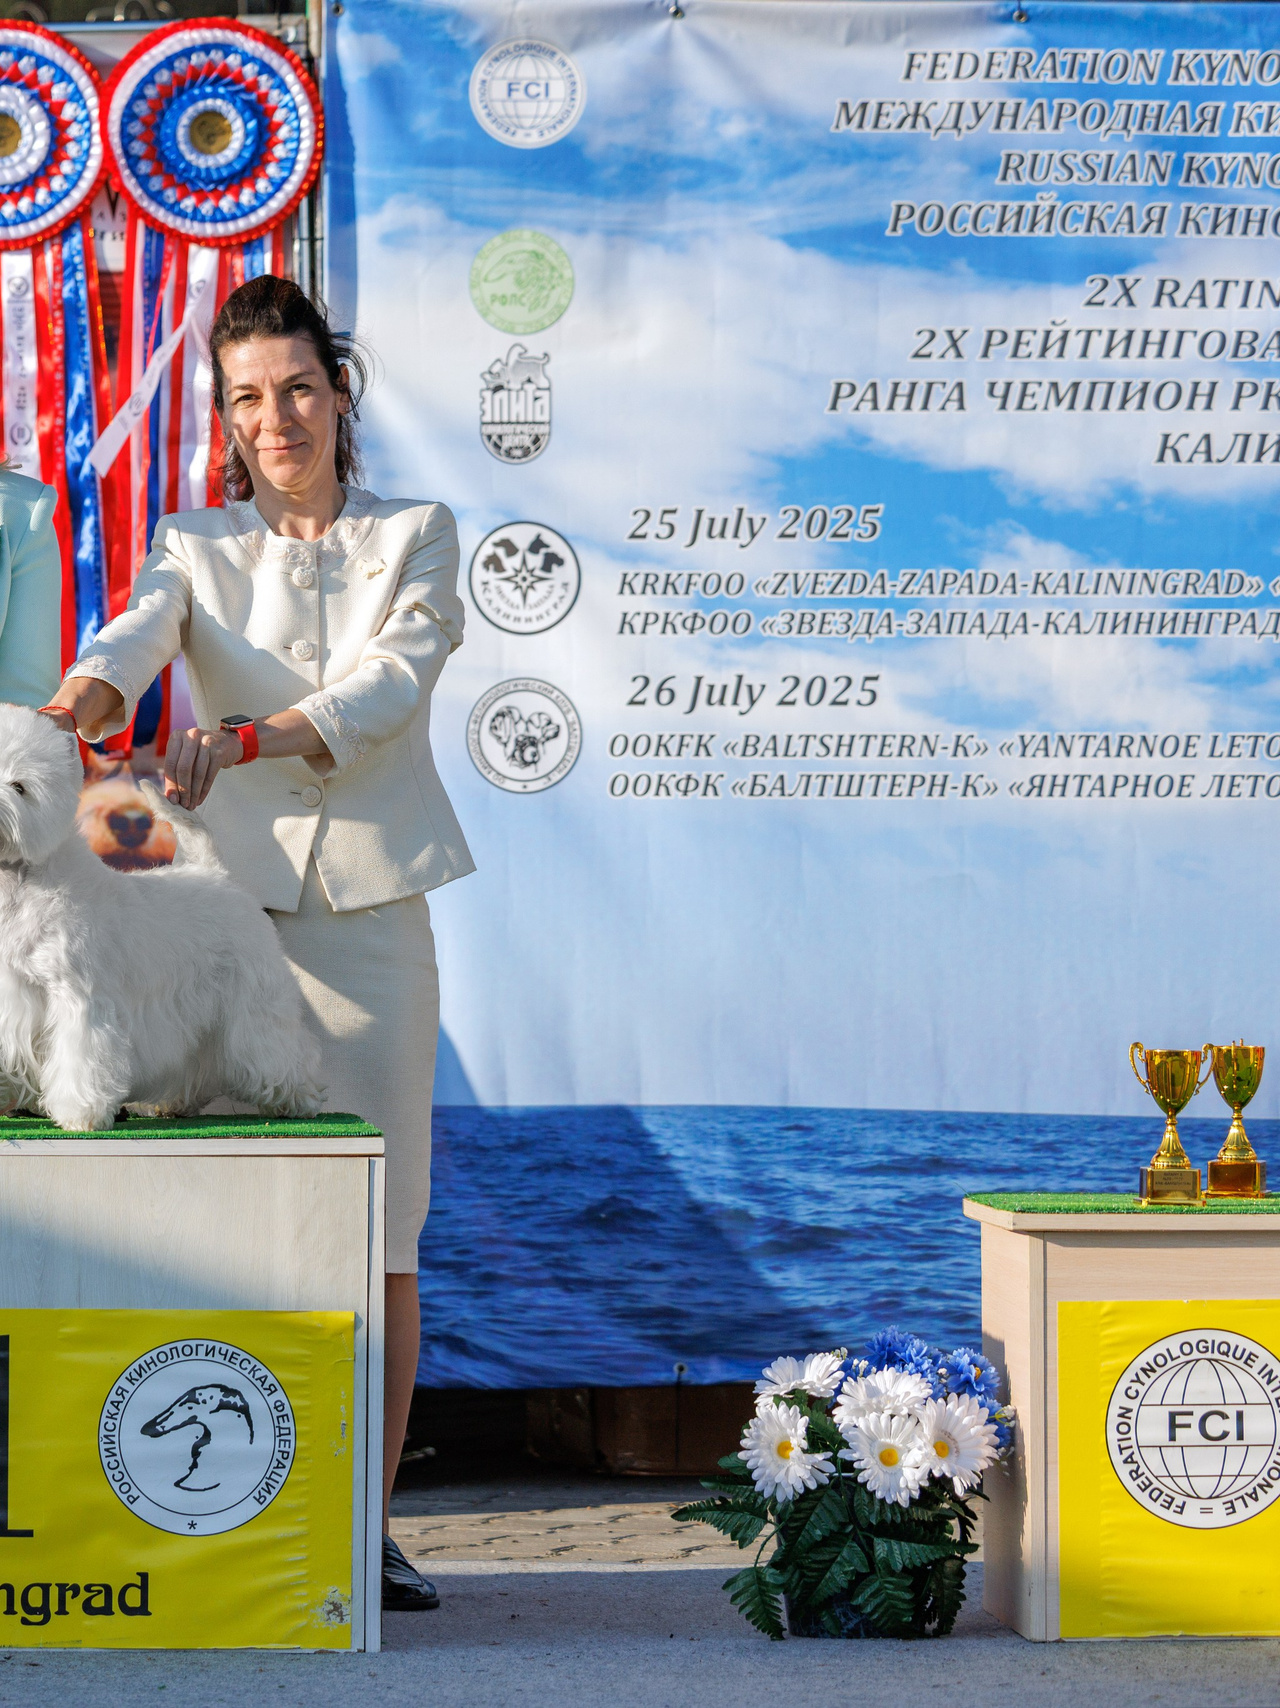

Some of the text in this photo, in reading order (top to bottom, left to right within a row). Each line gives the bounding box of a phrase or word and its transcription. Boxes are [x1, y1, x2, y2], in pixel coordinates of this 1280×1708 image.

[903, 51, 1280, 84] FEDERATION KYNO
[507, 81, 549, 99] FCI
[832, 99, 1223, 140] МЕЖДУНАРОДНАЯ
[998, 151, 1172, 185] RUSSIAN
[888, 193, 1167, 236] РОССИЙСКАЯ
[1084, 276, 1280, 309] 2X RATIN
[910, 320, 1280, 360] 2Х РЕЙТИНГОВА
[826, 380, 1280, 411] РАНГА ЧЕМПИОН РК
[1154, 432, 1280, 464] КАЛИ
[627, 506, 881, 548] 25 July 2025
[617, 570, 1262, 597] KRKFOO «ZVEZDA-ZAPADA-KALININGRAD»
[617, 610, 752, 637] КРКФОО
[627, 674, 880, 715] 26 July 2025
[608, 733, 1280, 760] OOKFK «BALTSHTERN-K» «YANTARNOE LETO
[608, 772, 1280, 800] ООКФК «БАЛТШТЕРН-К» «ЯНТАРНОЕ ЛЕТО
[1124, 1339, 1259, 1400] CYNOLOGIQUE
[99, 1344, 291, 1506] РОССИЙСКАЯ КИНОЛОГИЧЕСКАЯ ФЕДЕРАЦИЯ
[1168, 1409, 1245, 1442] FCI
[1116, 1405, 1187, 1516] FEDERATION
